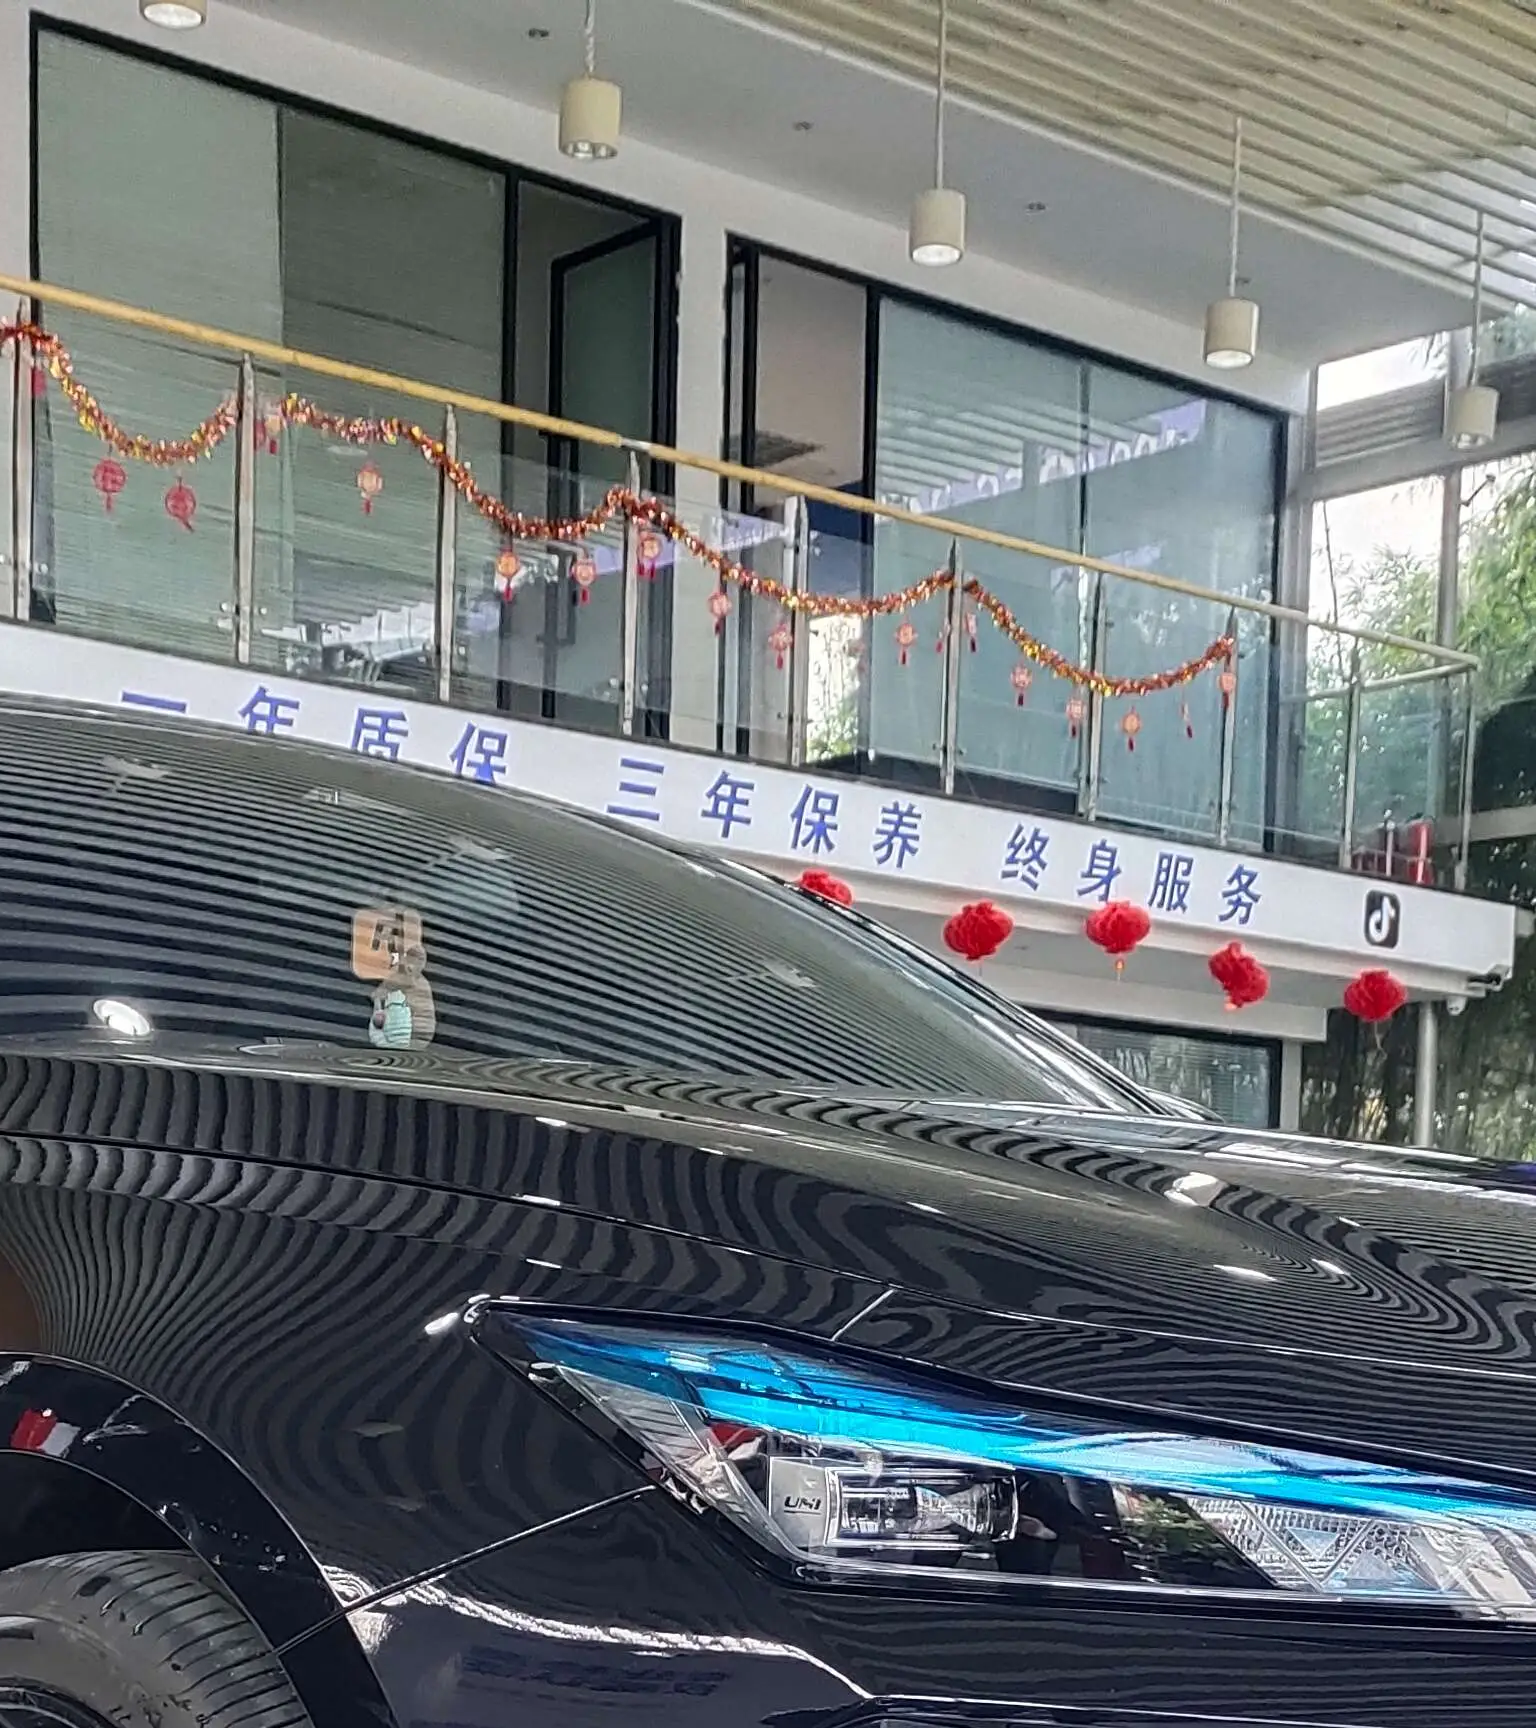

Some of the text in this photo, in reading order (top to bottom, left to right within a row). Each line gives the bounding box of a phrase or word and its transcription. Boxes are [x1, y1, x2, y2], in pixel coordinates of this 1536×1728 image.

[607, 757, 924, 868] 三年保养
[1000, 822, 1263, 926] 终身服务
